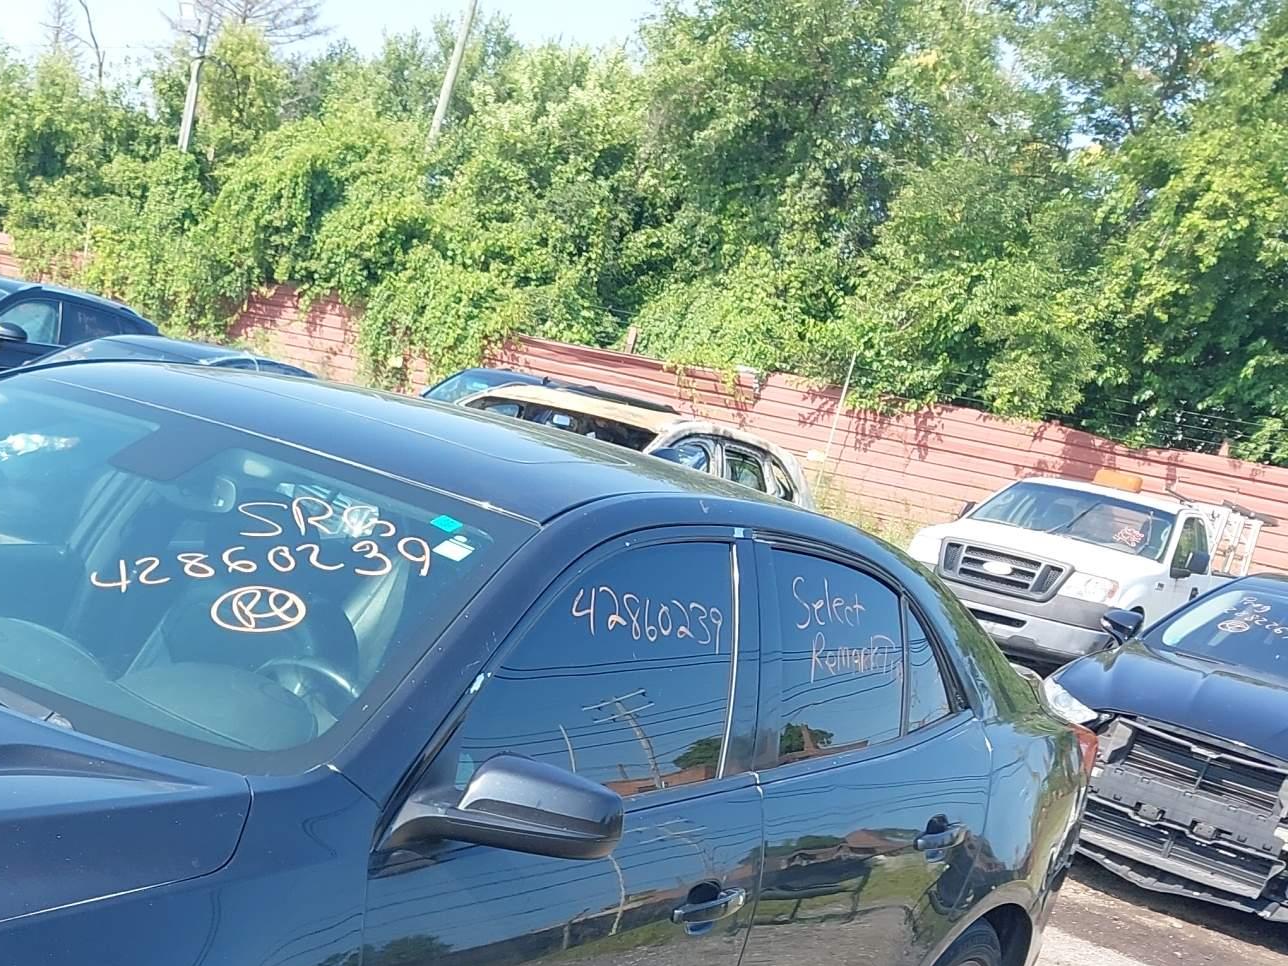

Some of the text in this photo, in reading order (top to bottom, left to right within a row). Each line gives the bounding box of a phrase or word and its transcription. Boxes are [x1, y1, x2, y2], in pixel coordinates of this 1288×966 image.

[91, 536, 432, 593] 42860239
[571, 586, 723, 655] 42860239
[792, 576, 866, 629] Select
